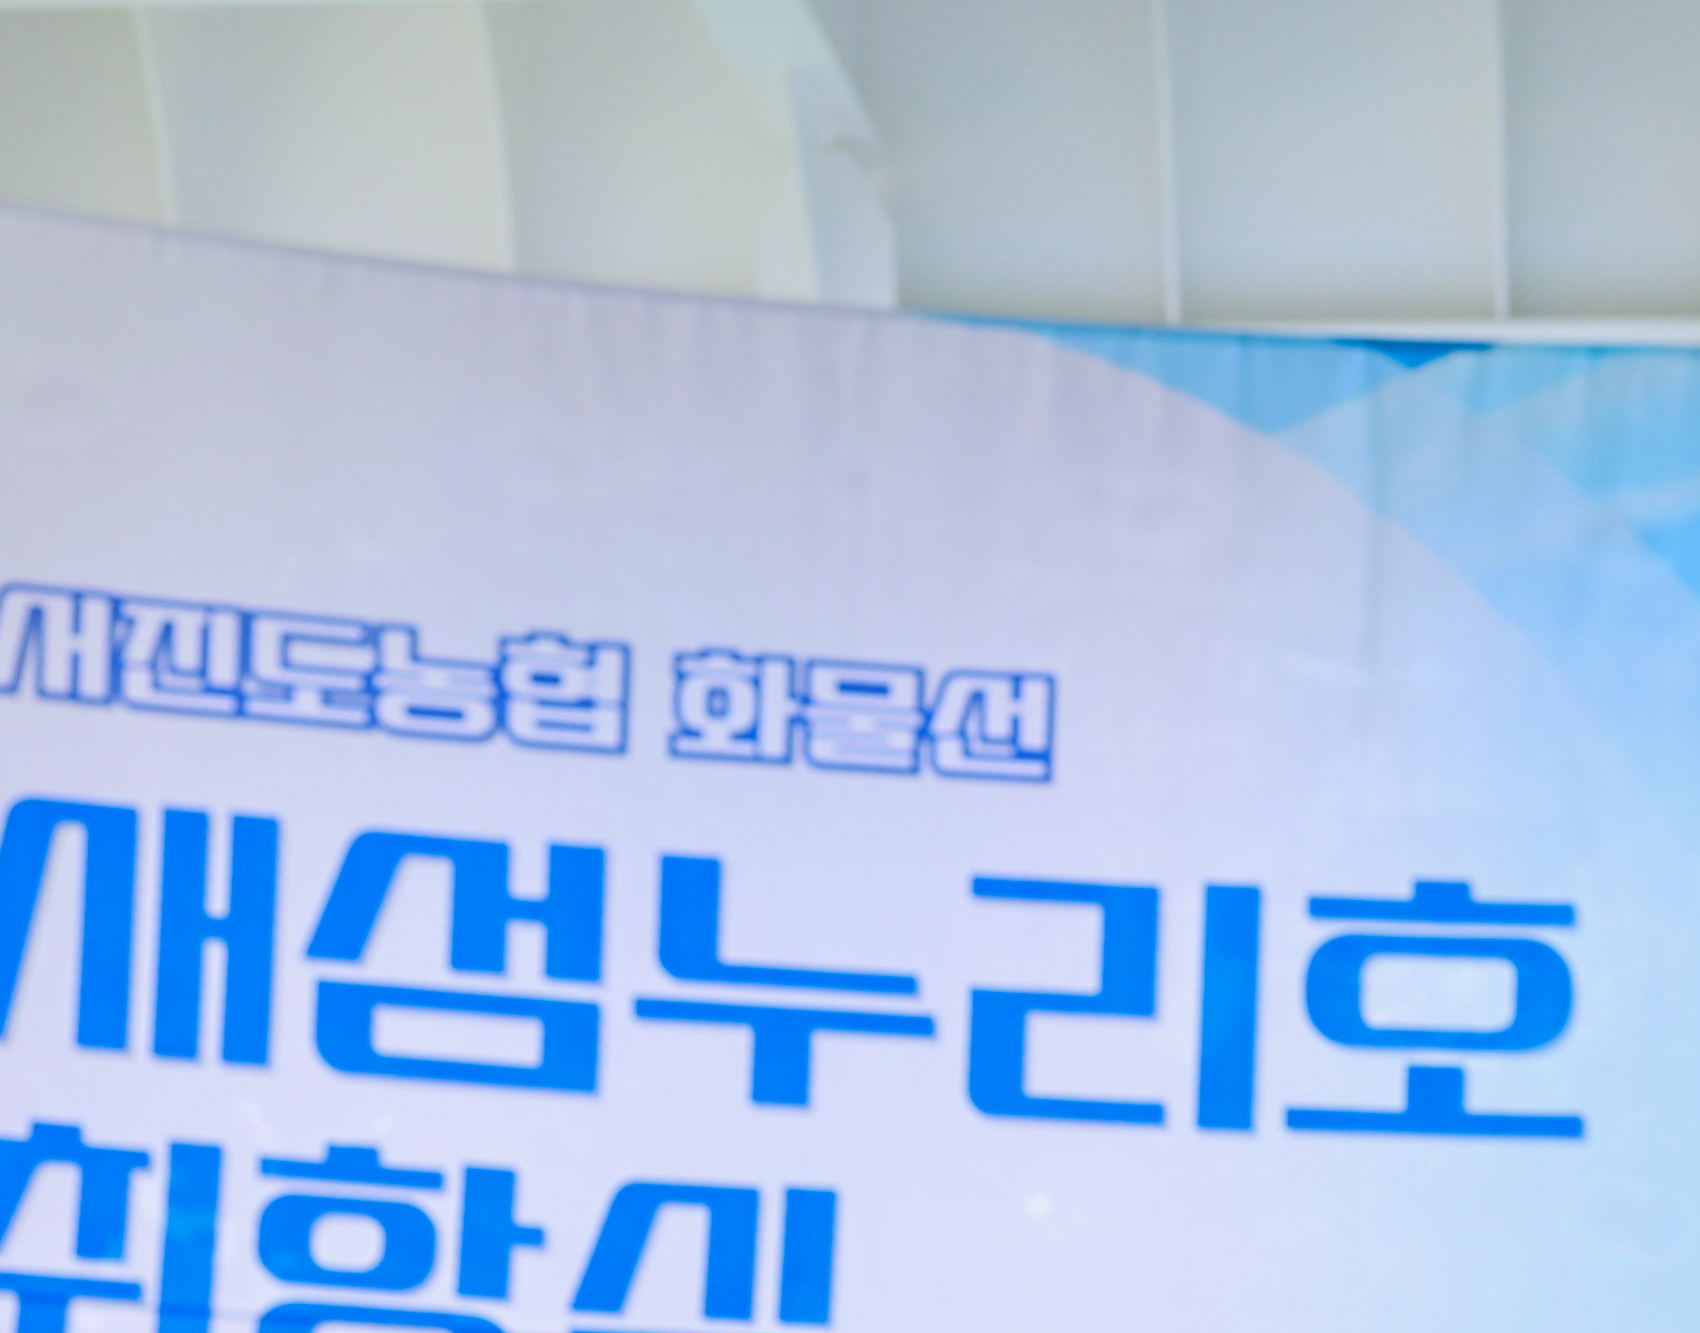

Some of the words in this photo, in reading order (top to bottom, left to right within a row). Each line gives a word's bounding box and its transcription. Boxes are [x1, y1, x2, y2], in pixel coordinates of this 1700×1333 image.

[0, 582, 630, 754] 서진도농협
[668, 642, 1058, 784] 화물선
[0, 795, 1586, 1140] 새섬누리호
